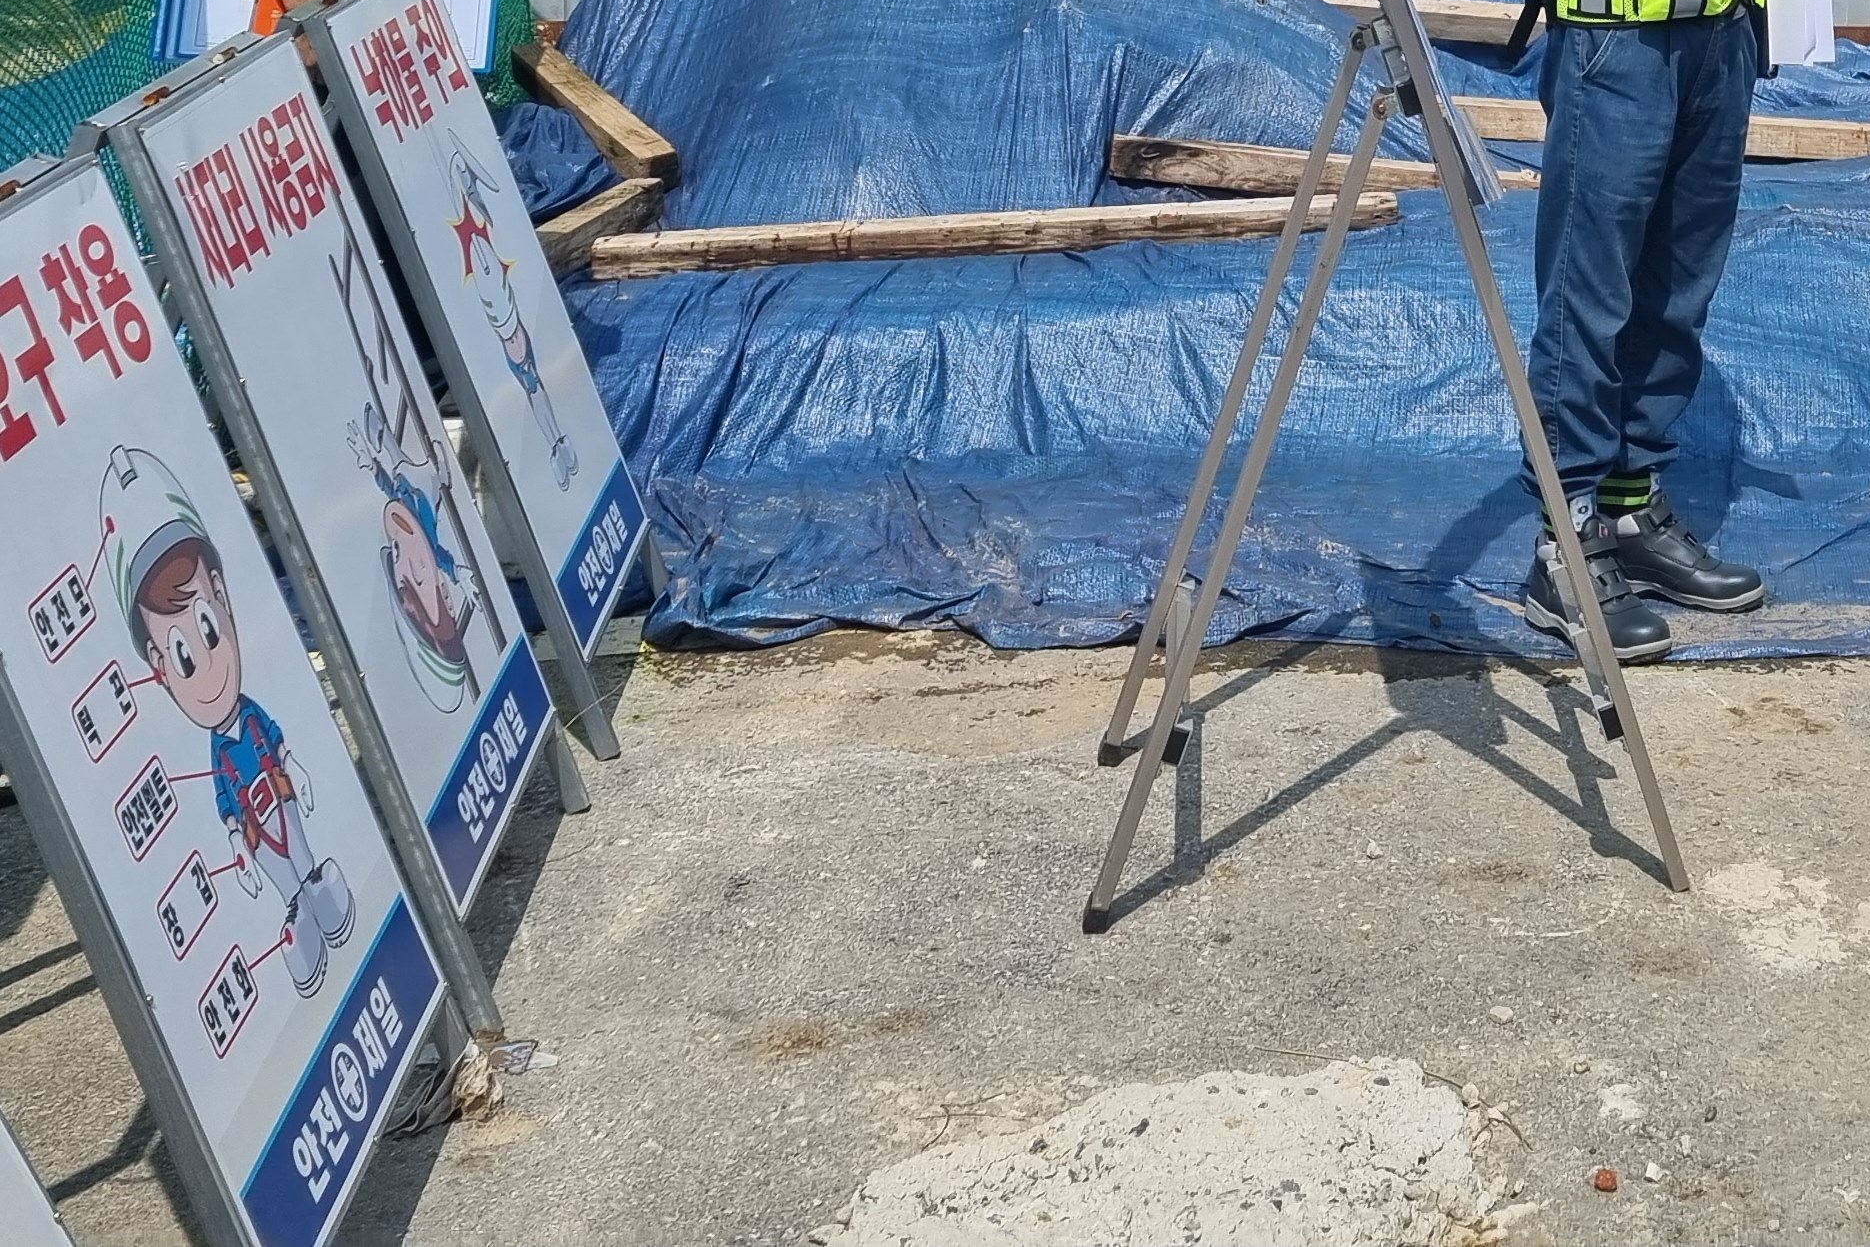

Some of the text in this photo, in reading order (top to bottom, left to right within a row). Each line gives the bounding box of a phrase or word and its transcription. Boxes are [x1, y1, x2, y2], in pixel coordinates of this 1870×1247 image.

[350, 16, 435, 144] 낙하물
[174, 92, 342, 290] 사다리 사용금지
[39, 224, 152, 380] 착용
[34, 574, 91, 654] 안전모
[577, 549, 604, 608] 안전
[121, 766, 173, 851] 안전벨트
[457, 690, 528, 846] 안전 제일
[205, 958, 255, 1047] 안전화
[291, 975, 404, 1205] 안전 제일
